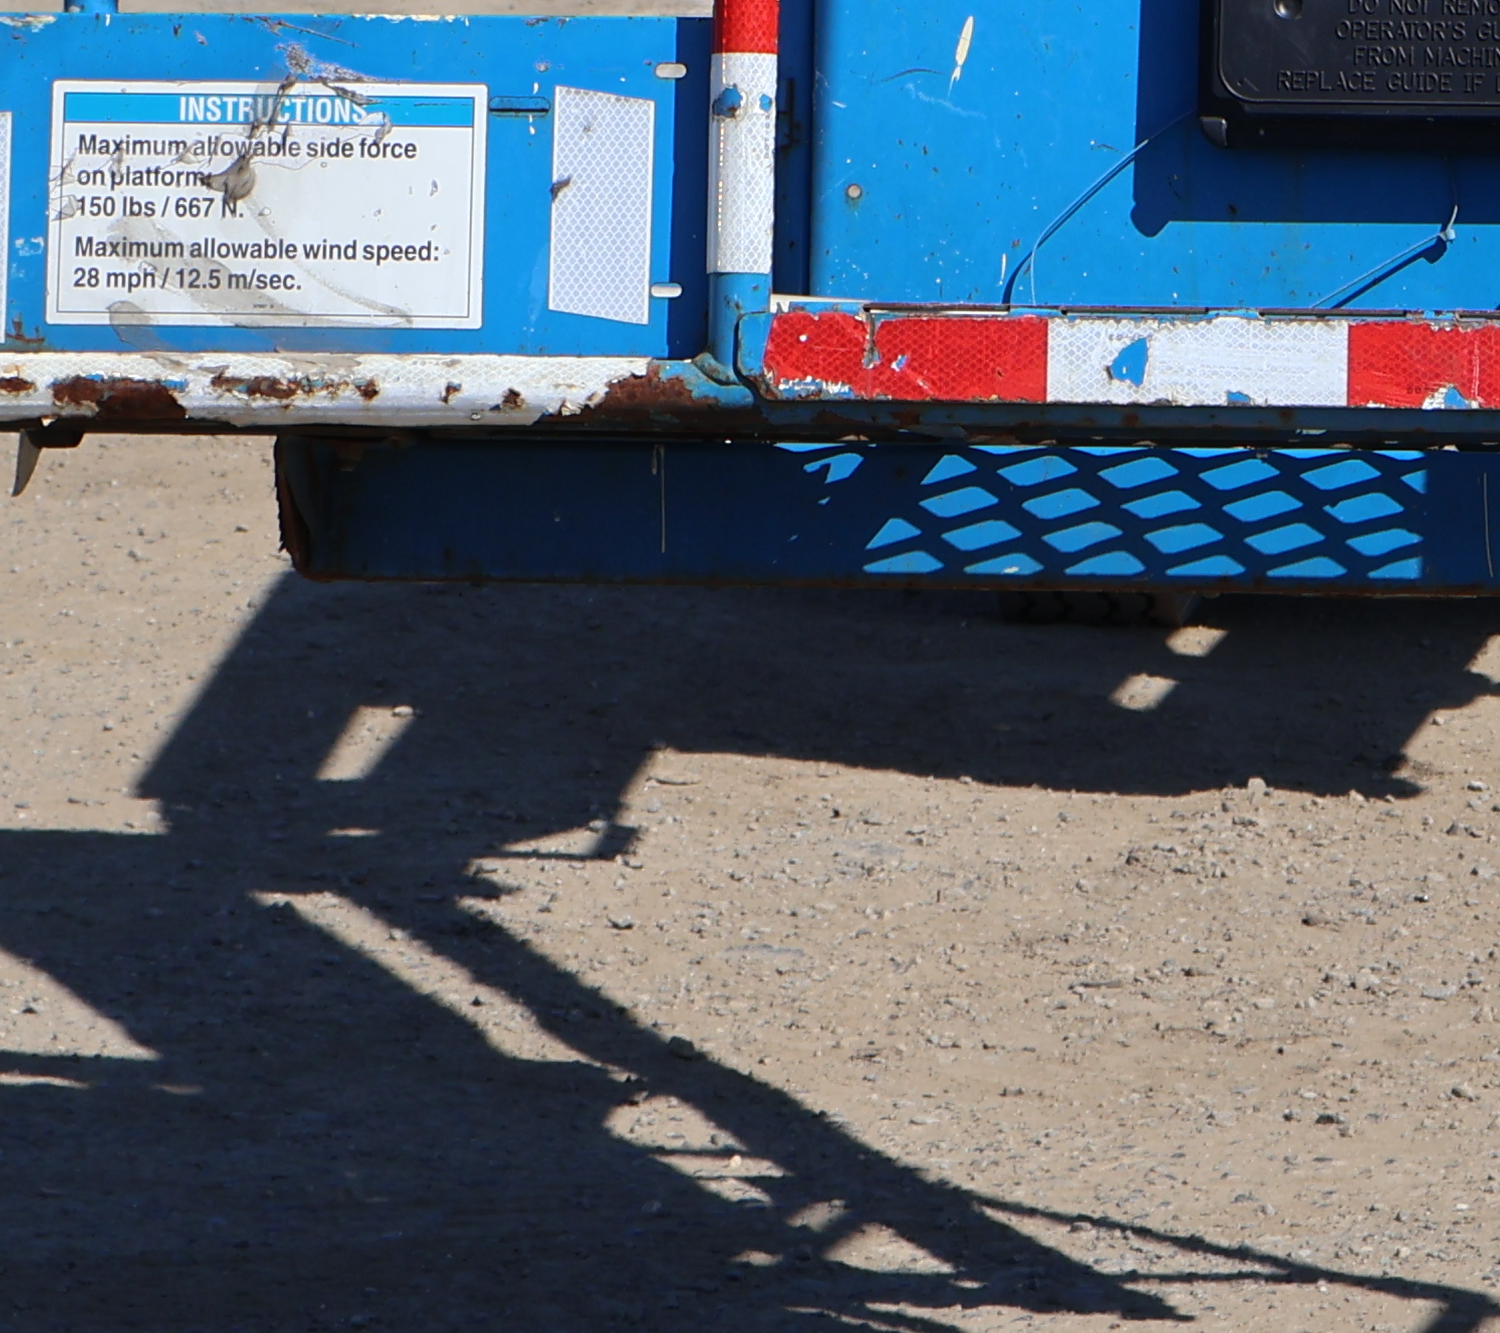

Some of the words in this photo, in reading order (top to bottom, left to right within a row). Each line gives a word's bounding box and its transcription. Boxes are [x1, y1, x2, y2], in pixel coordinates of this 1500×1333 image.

[1336, 19, 1466, 42] OPERATOR'S
[1353, 46, 1416, 67] FROM
[1277, 70, 1376, 92] REPLACE
[1387, 72, 1453, 93] GUIDE
[1464, 73, 1485, 93] IF
[179, 97, 366, 124] INSTRUCTIONS
[79, 135, 188, 157] Maximum
[194, 137, 300, 159] allowable
[306, 137, 354, 159] side
[359, 138, 417, 160] force
[77, 170, 105, 184] on
[77, 196, 116, 217] 150
[122, 196, 156, 217] lbs
[160, 197, 170, 217] /
[175, 197, 215, 218] 667
[221, 198, 244, 218] N.
[75, 237, 184, 259] Maximum
[190, 238, 298, 261] allowable
[303, 239, 357, 262] wind
[362, 240, 440, 266] speed:
[74, 269, 100, 289] 28
[106, 269, 156, 295] mph
[160, 269, 170, 290] /
[175, 270, 221, 290] 12.5
[227, 270, 302, 292] m/sec.
